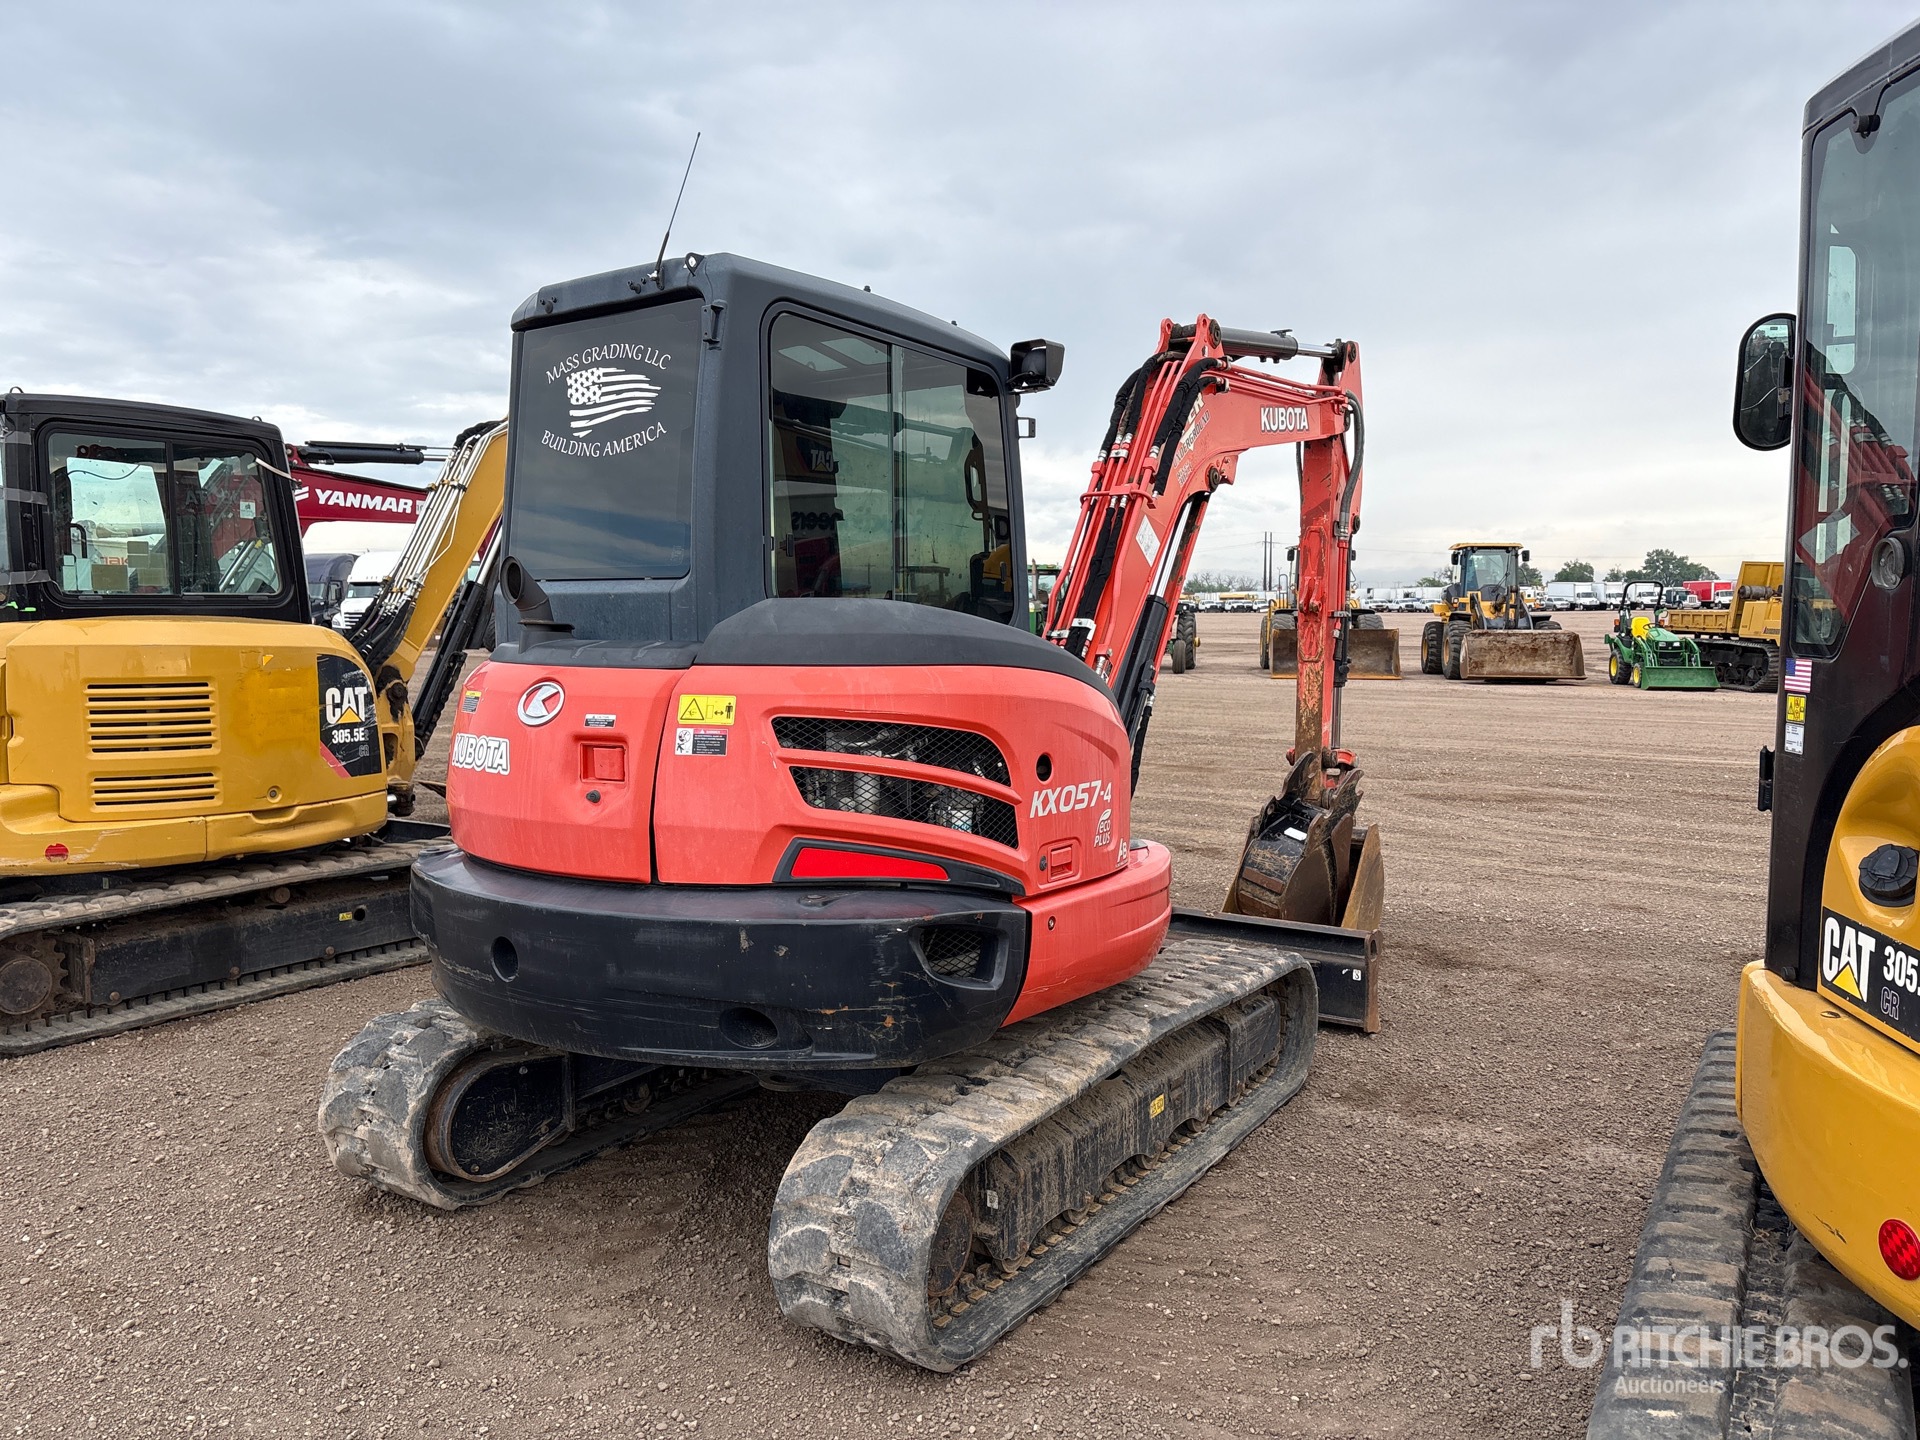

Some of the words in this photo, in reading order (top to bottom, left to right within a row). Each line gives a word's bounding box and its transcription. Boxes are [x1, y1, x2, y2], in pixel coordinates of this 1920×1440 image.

[545, 353, 579, 384] MASS
[582, 343, 644, 364] GRADING
[644, 347, 671, 370] LLC
[1260, 405, 1309, 432] KUBOTA
[541, 429, 601, 457] BUILDING
[602, 421, 667, 456] AMERICA
[314, 488, 413, 514] YANMAR
[325, 686, 368, 725] CAT
[453, 733, 511, 775] KUBOTA
[1029, 779, 1112, 819] KX057-4
[1093, 832, 1111, 848] PLUS
[1822, 916, 1876, 1003] CAT
[1880, 986, 1900, 1021] CR
